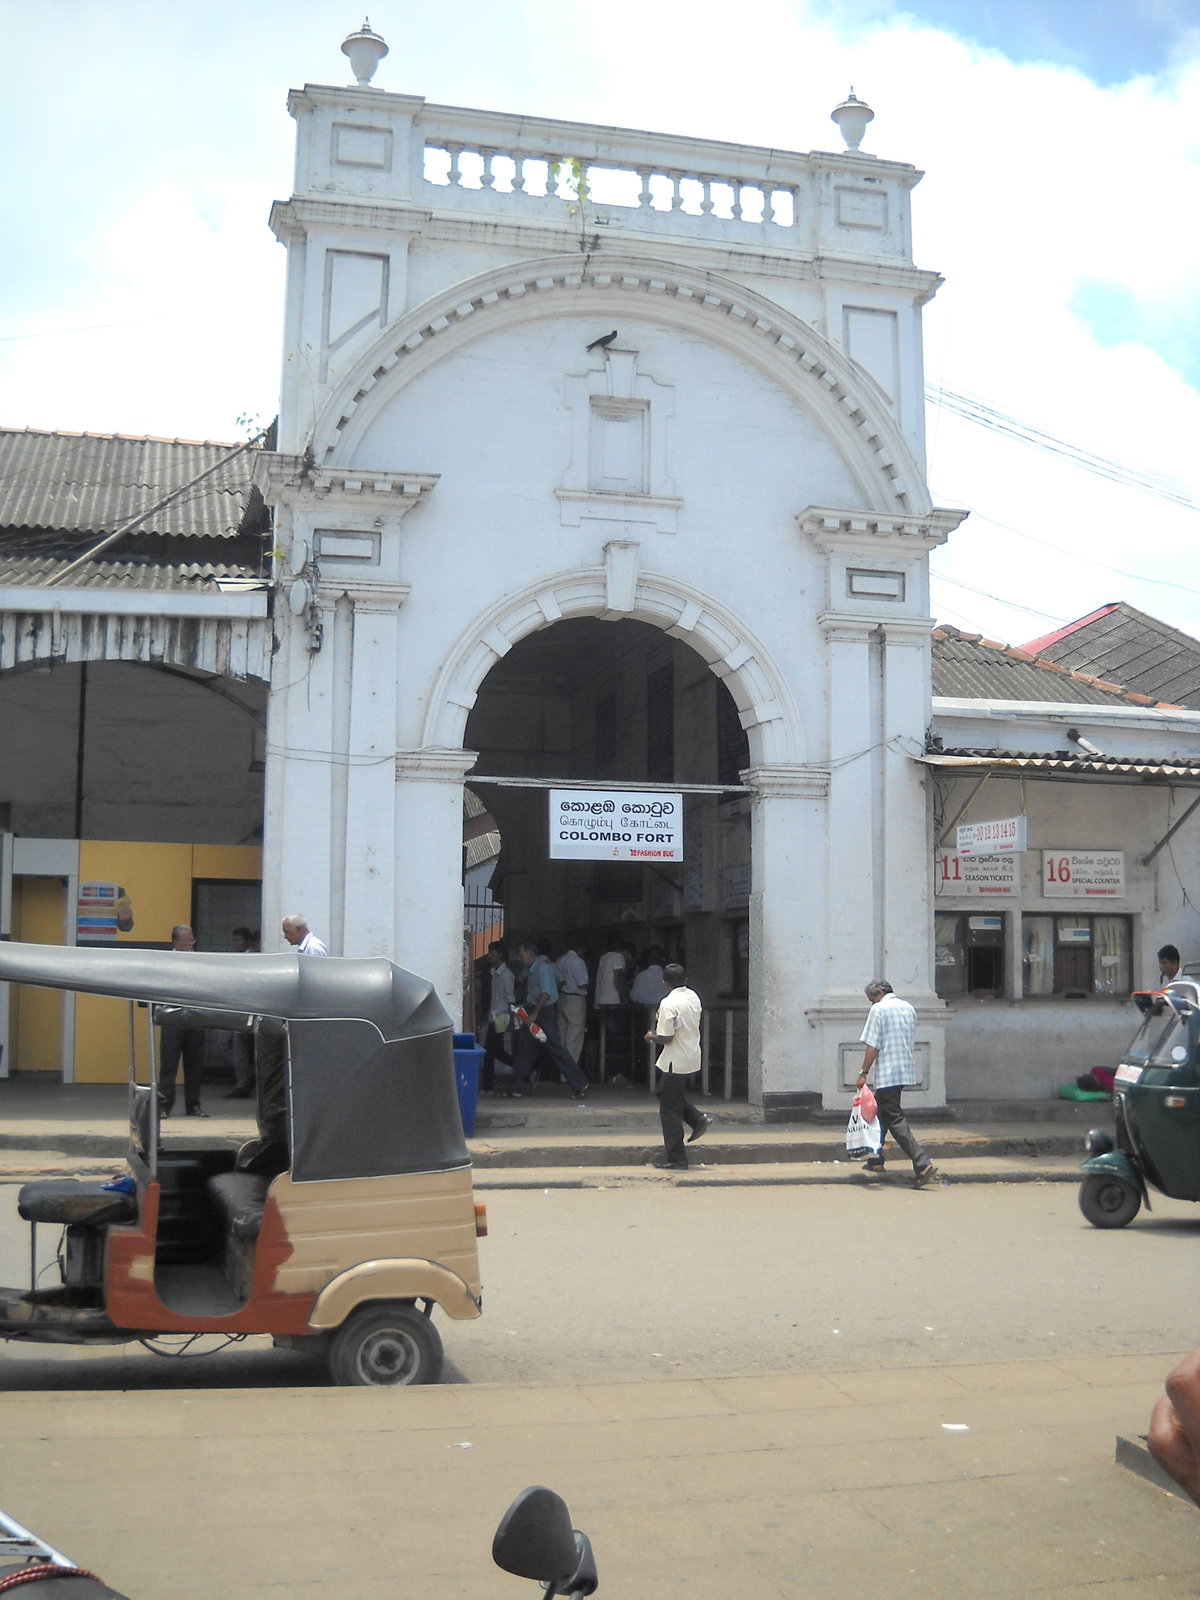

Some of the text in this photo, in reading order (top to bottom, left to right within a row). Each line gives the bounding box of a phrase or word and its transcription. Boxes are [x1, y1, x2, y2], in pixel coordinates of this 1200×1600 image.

[560, 800, 674, 817] කොළඹ කොටුව
[559, 815, 674, 830] கொழும்பு கோட்டை
[977, 826, 984, 841] 10
[985, 825, 992, 840] 12
[993, 824, 1000, 839] 13
[1001, 823, 1008, 838] 14
[1009, 822, 1016, 837] 15
[559, 831, 674, 843] COLOMBO FORT
[941, 855, 961, 880] 11
[1047, 857, 1071, 882] 16
